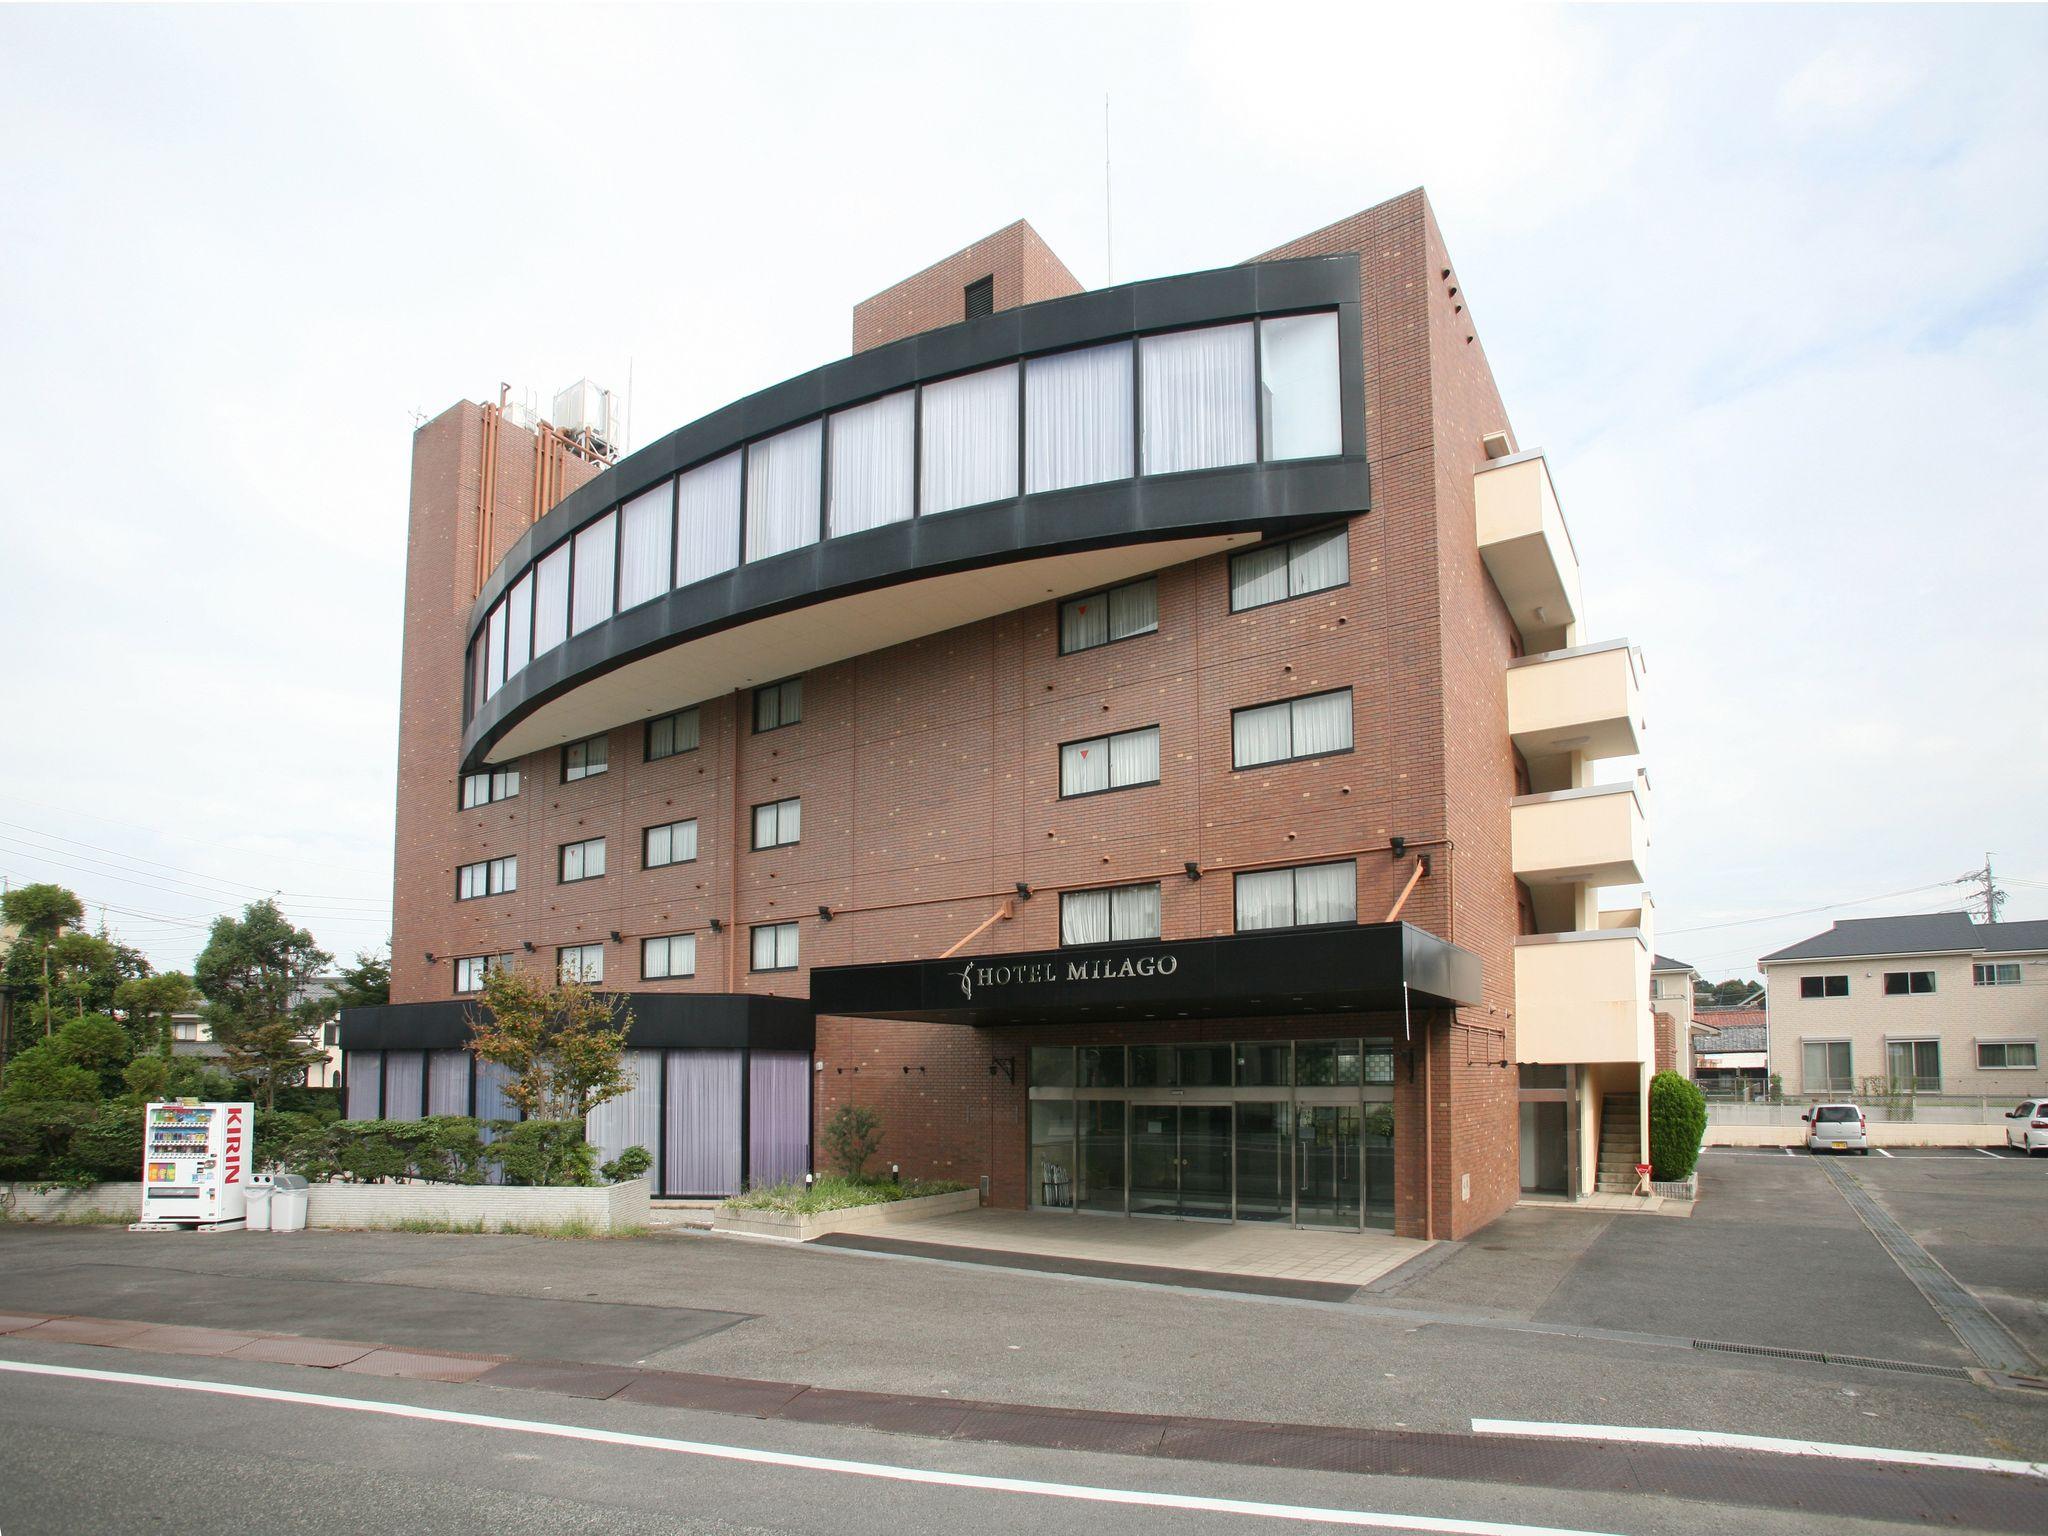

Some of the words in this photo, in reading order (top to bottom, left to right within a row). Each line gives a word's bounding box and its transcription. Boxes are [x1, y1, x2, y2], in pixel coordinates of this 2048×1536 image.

[977, 963, 1057, 986] HOTEL
[1066, 955, 1178, 981] MILAGO
[225, 1107, 242, 1184] KIRIN
